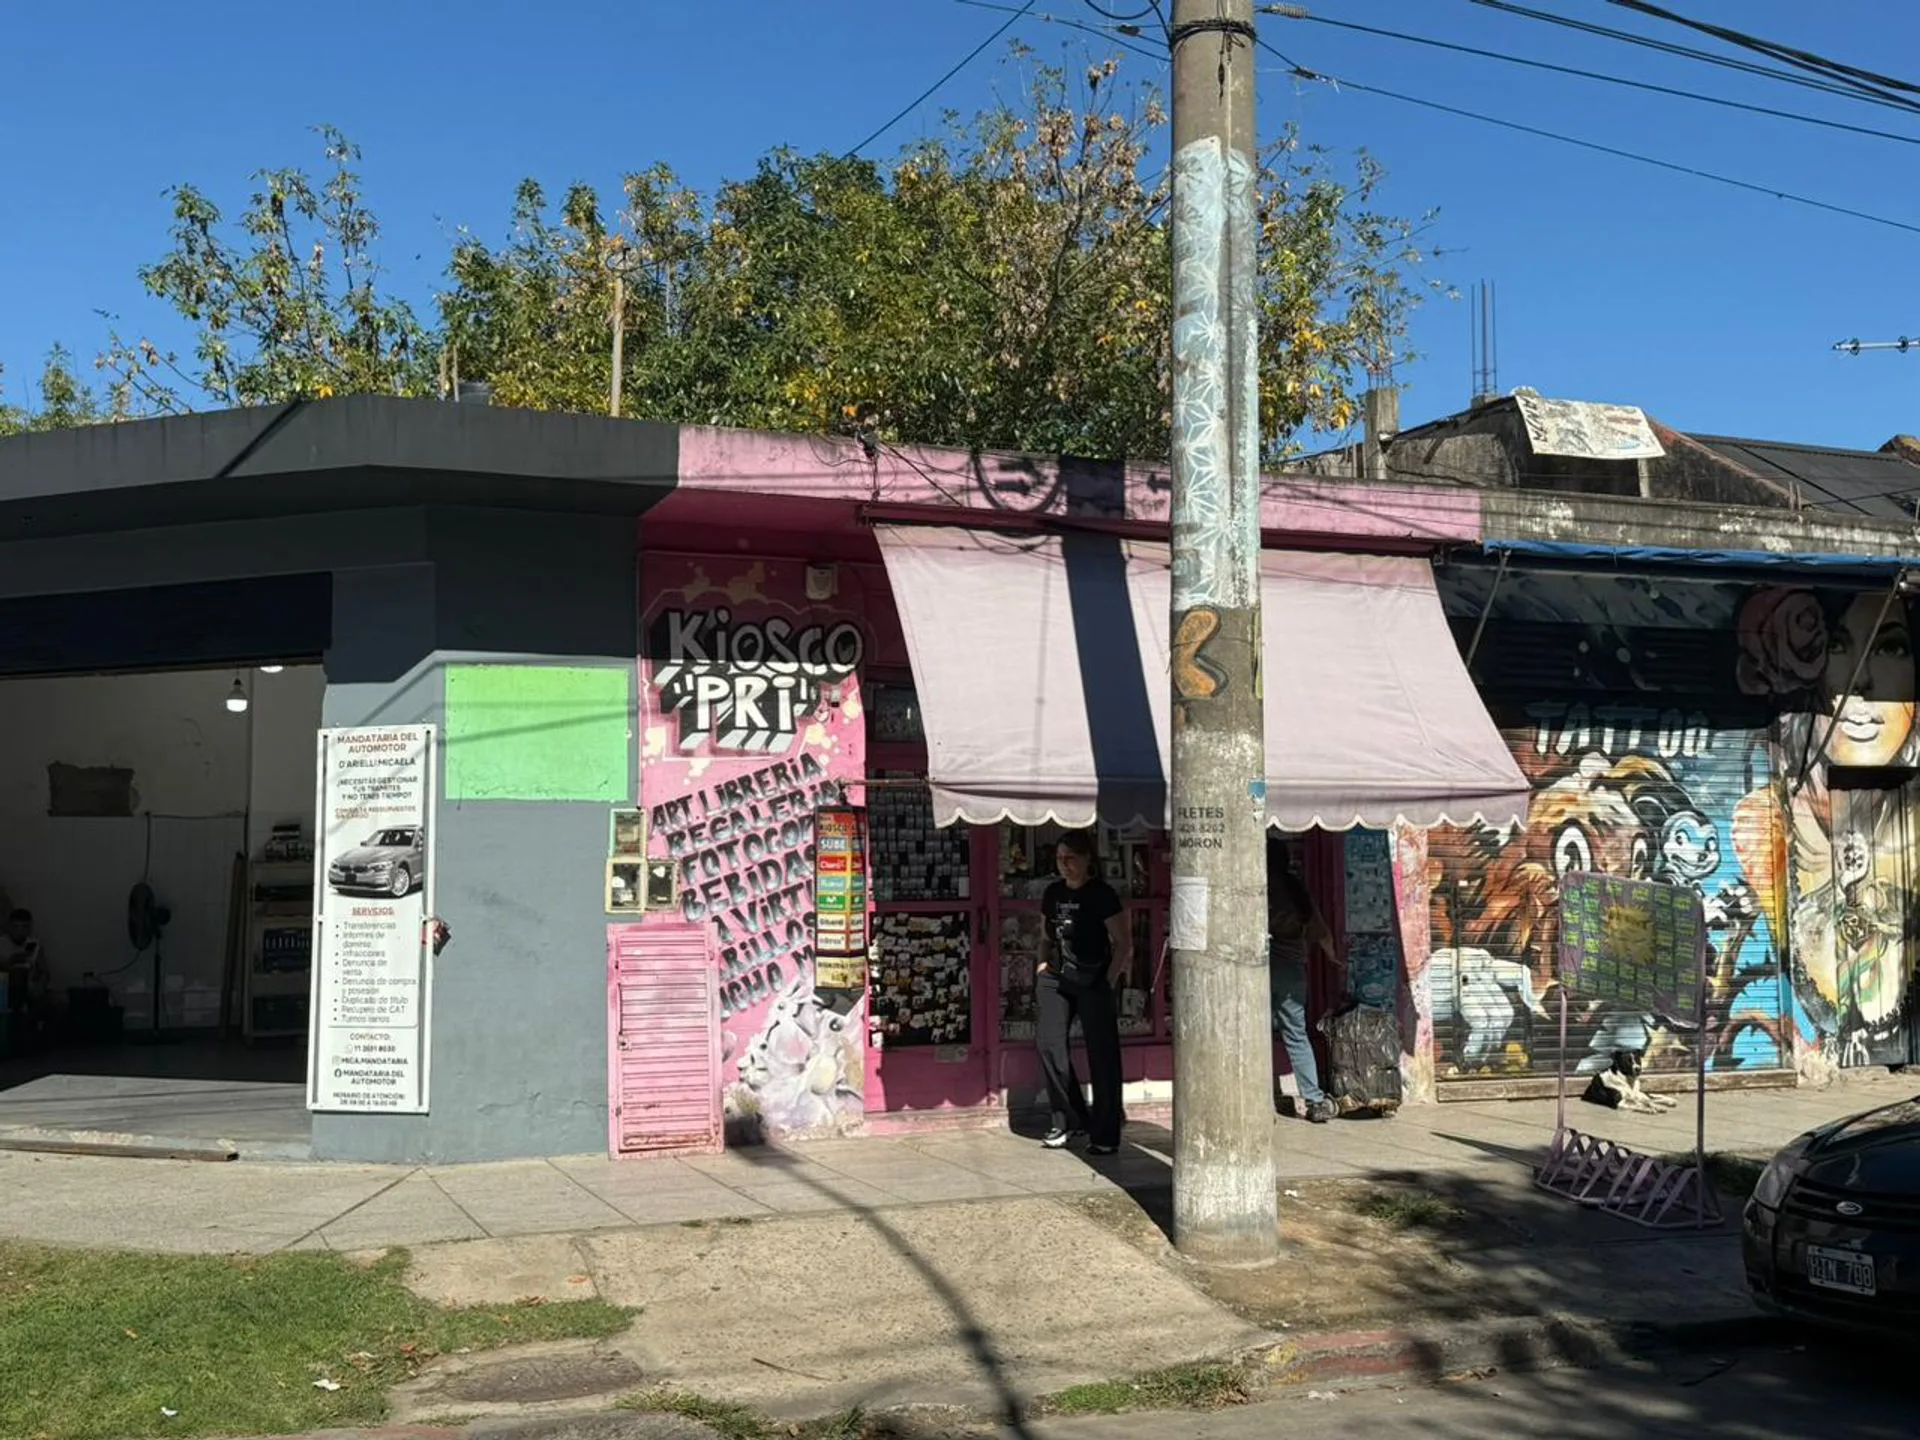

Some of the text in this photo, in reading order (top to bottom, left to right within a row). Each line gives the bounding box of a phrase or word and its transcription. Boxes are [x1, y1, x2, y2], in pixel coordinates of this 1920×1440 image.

[337, 732, 418, 744] MANDATARIA DEL
[348, 744, 407, 753] AUTOMOTOR
[378, 758, 416, 766] MICAELA
